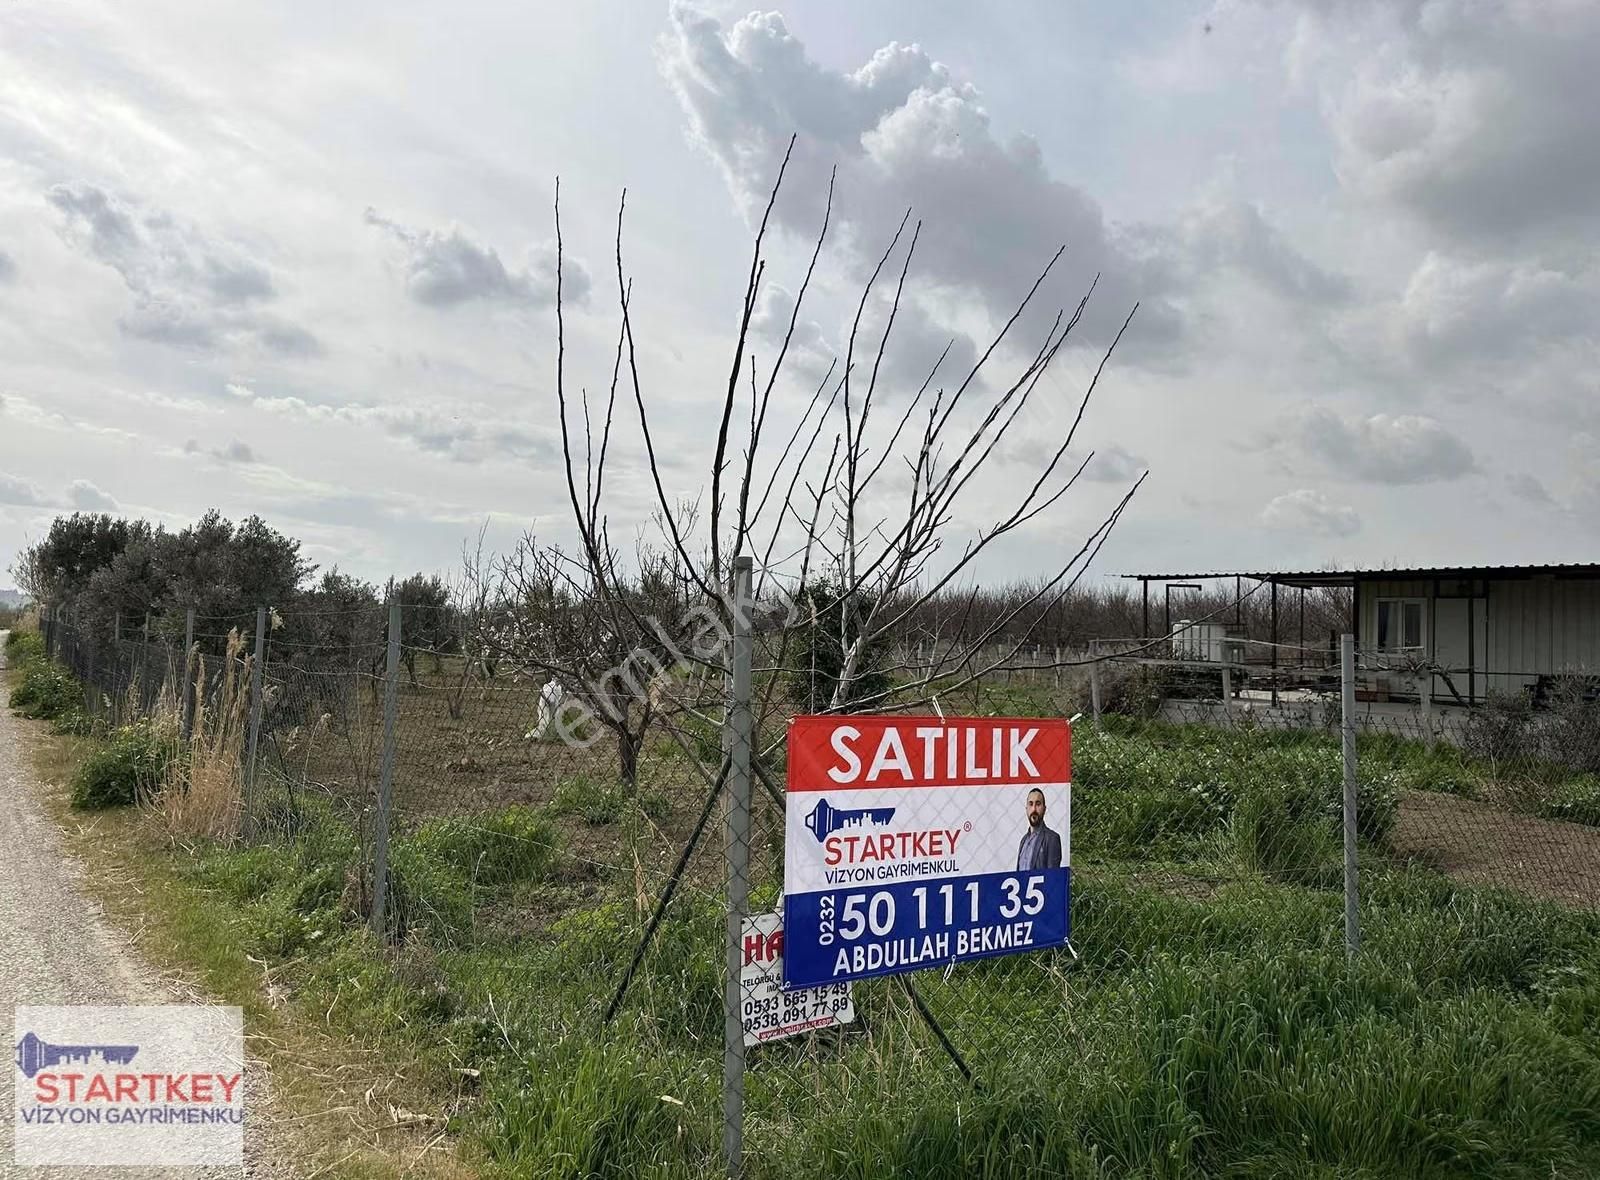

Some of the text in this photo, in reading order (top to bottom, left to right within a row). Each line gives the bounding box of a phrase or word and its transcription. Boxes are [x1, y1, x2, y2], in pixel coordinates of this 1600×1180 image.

[827, 726, 1041, 784] SATILIK
[824, 829, 962, 866] STARTKEY
[825, 859, 959, 884] VİZYON GAYRİMENKUL
[819, 894, 835, 945] 0232
[838, 876, 1045, 940] 50 111 35
[833, 921, 1033, 976] ABDULLAH BEKMEZ
[744, 982, 848, 1016] 0533 665 15 49
[744, 997, 848, 1032] 0538 091 77 89
